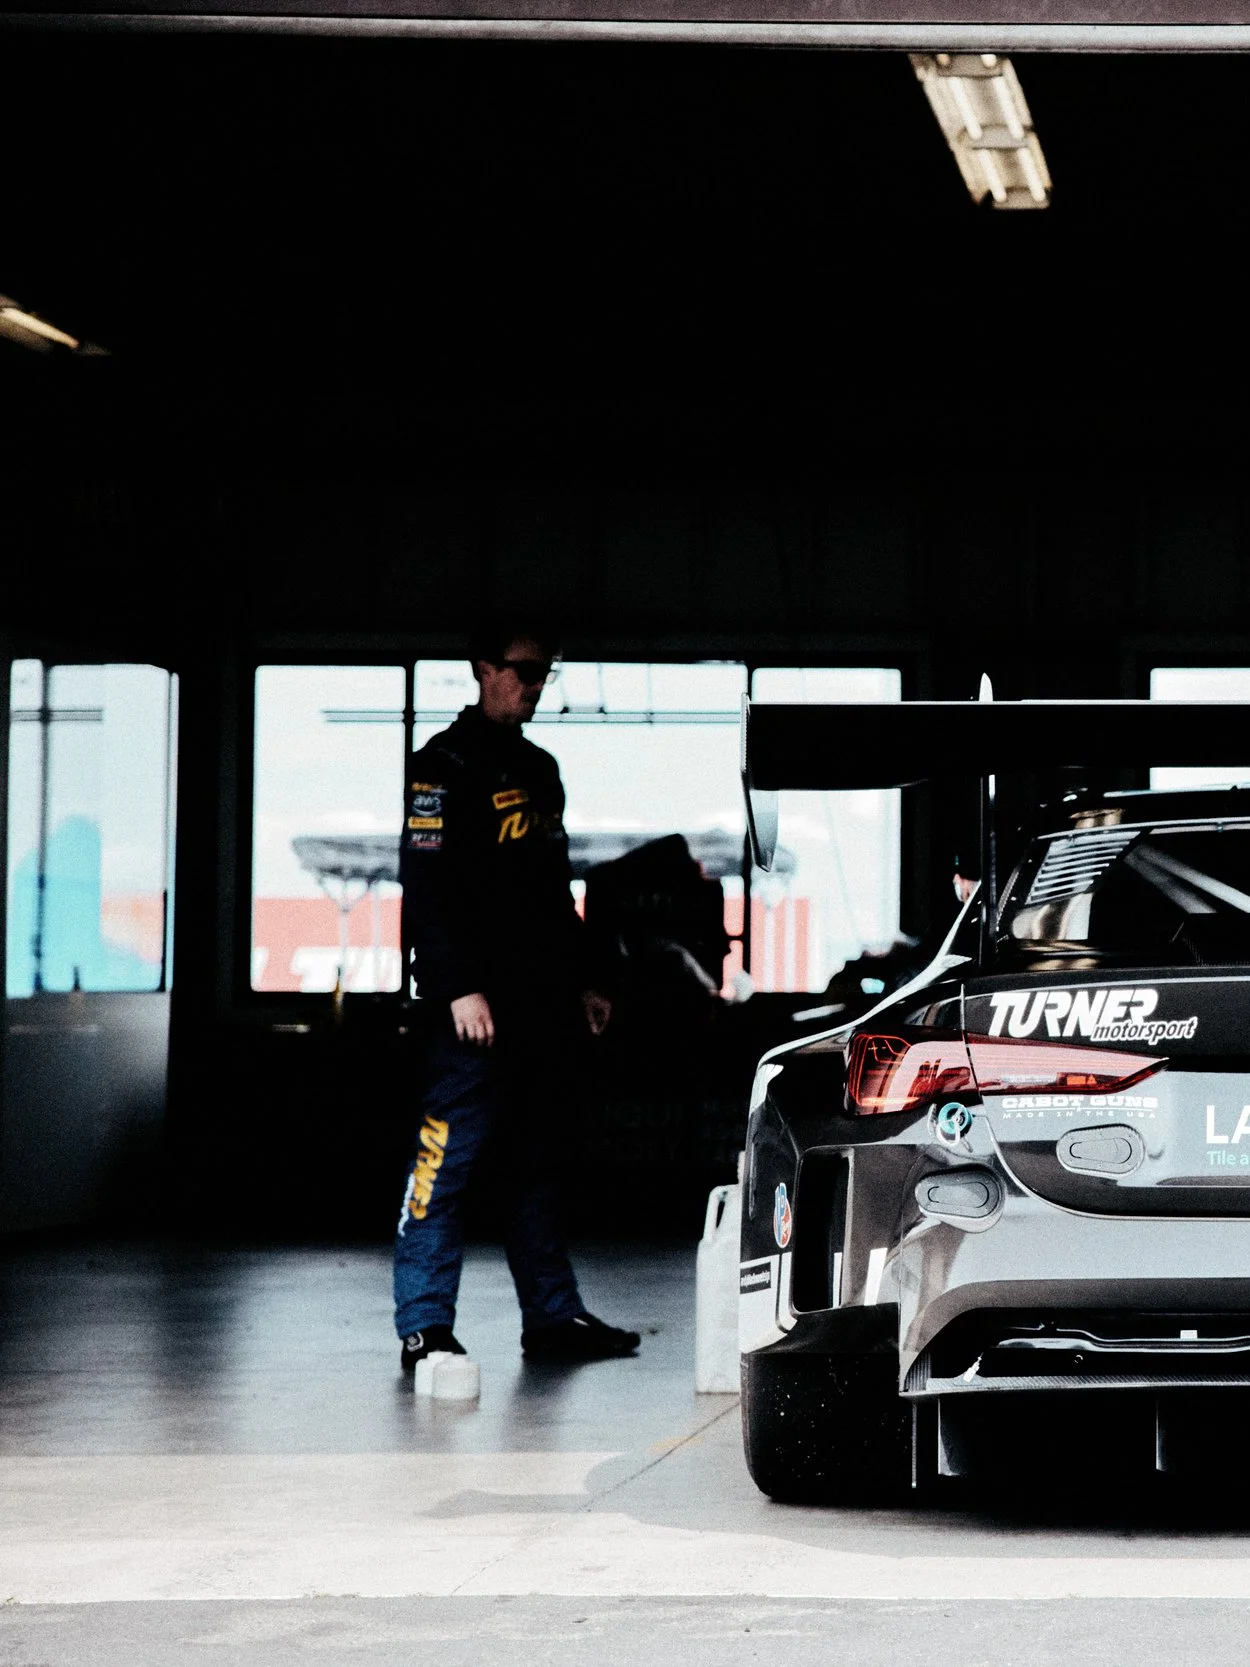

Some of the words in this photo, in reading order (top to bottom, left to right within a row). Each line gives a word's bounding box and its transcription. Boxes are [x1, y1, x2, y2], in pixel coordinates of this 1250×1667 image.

[987, 987, 1159, 1038] TURNER
[1091, 1016, 1198, 1045] motorsport
[1001, 1096, 1085, 1109] CABOT
[1089, 1095, 1160, 1109] GUNS
[1002, 1110, 1045, 1120] MADE
[1056, 1110, 1074, 1118] IN
[1086, 1110, 1115, 1118] THE
[1126, 1110, 1157, 1119] USA
[1207, 1150, 1237, 1166] Tile
